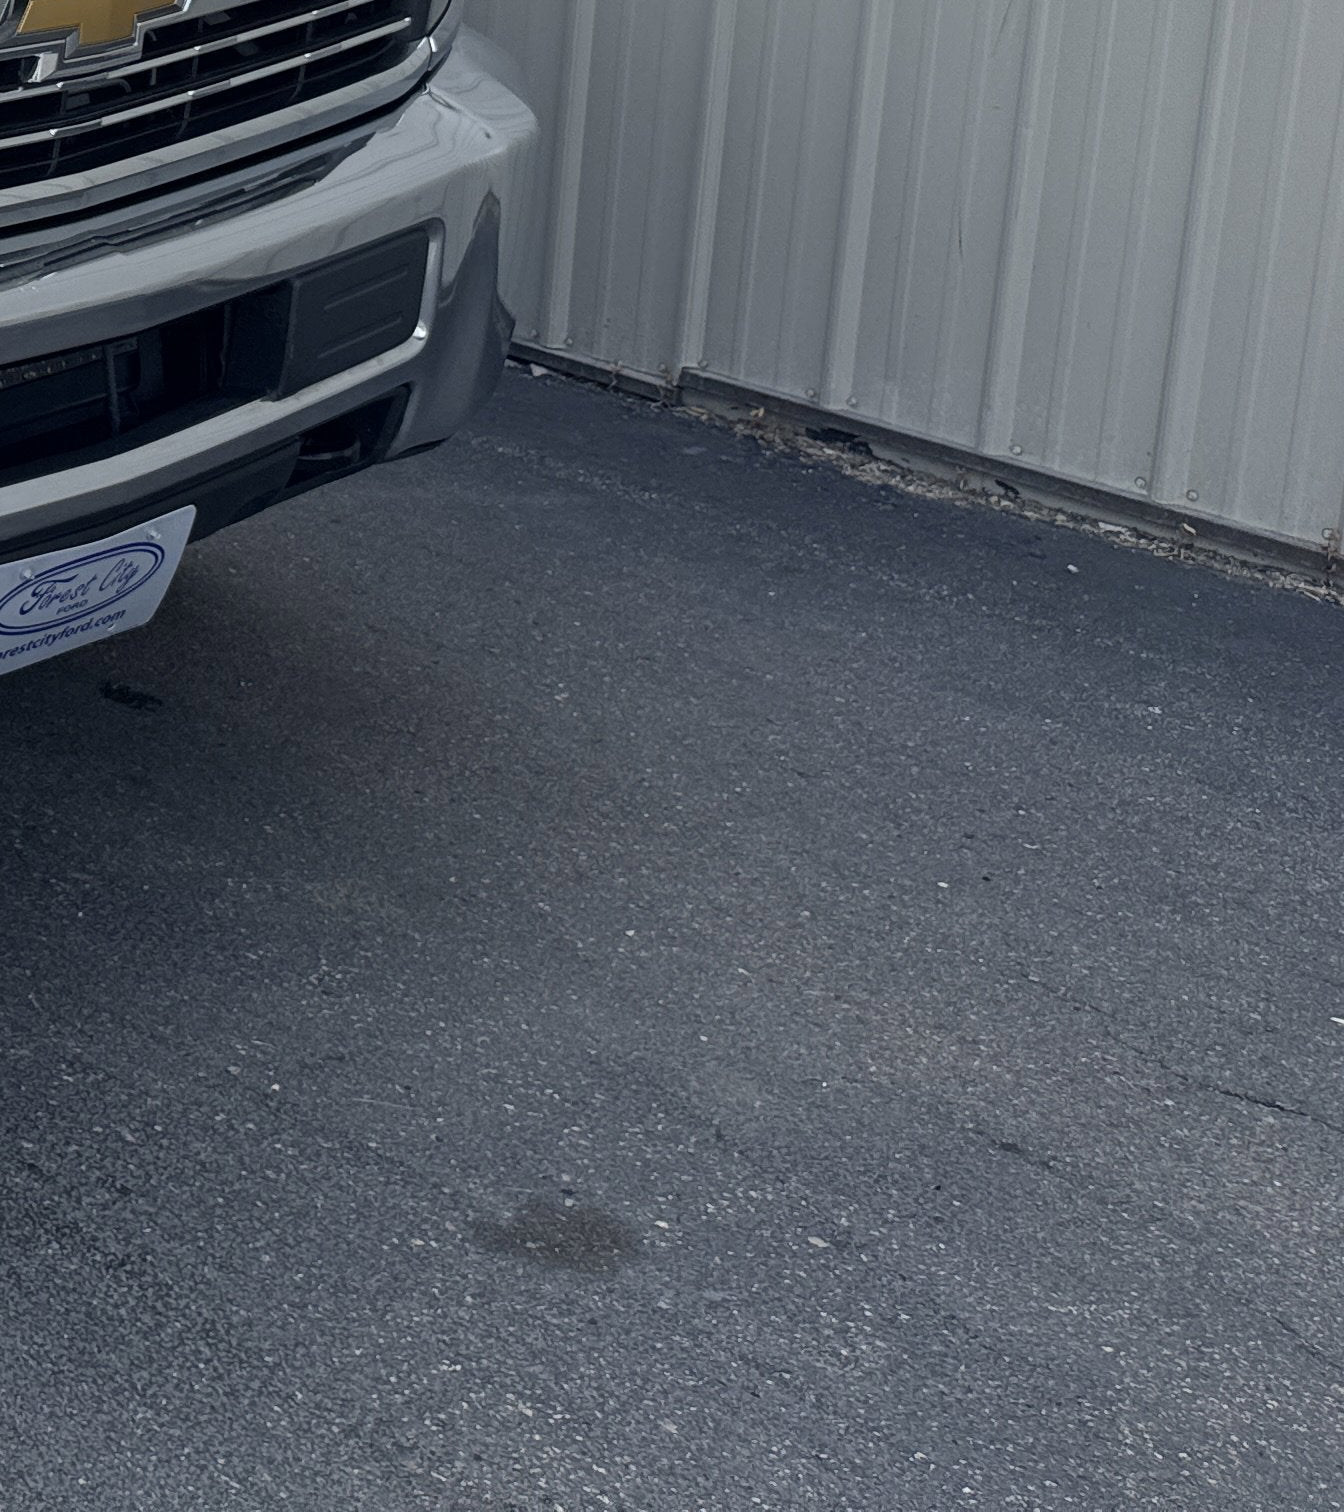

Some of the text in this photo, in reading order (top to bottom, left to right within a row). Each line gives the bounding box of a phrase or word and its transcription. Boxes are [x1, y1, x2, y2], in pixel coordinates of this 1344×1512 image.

[19, 557, 140, 616] Forest City
[55, 598, 89, 616] FORD
